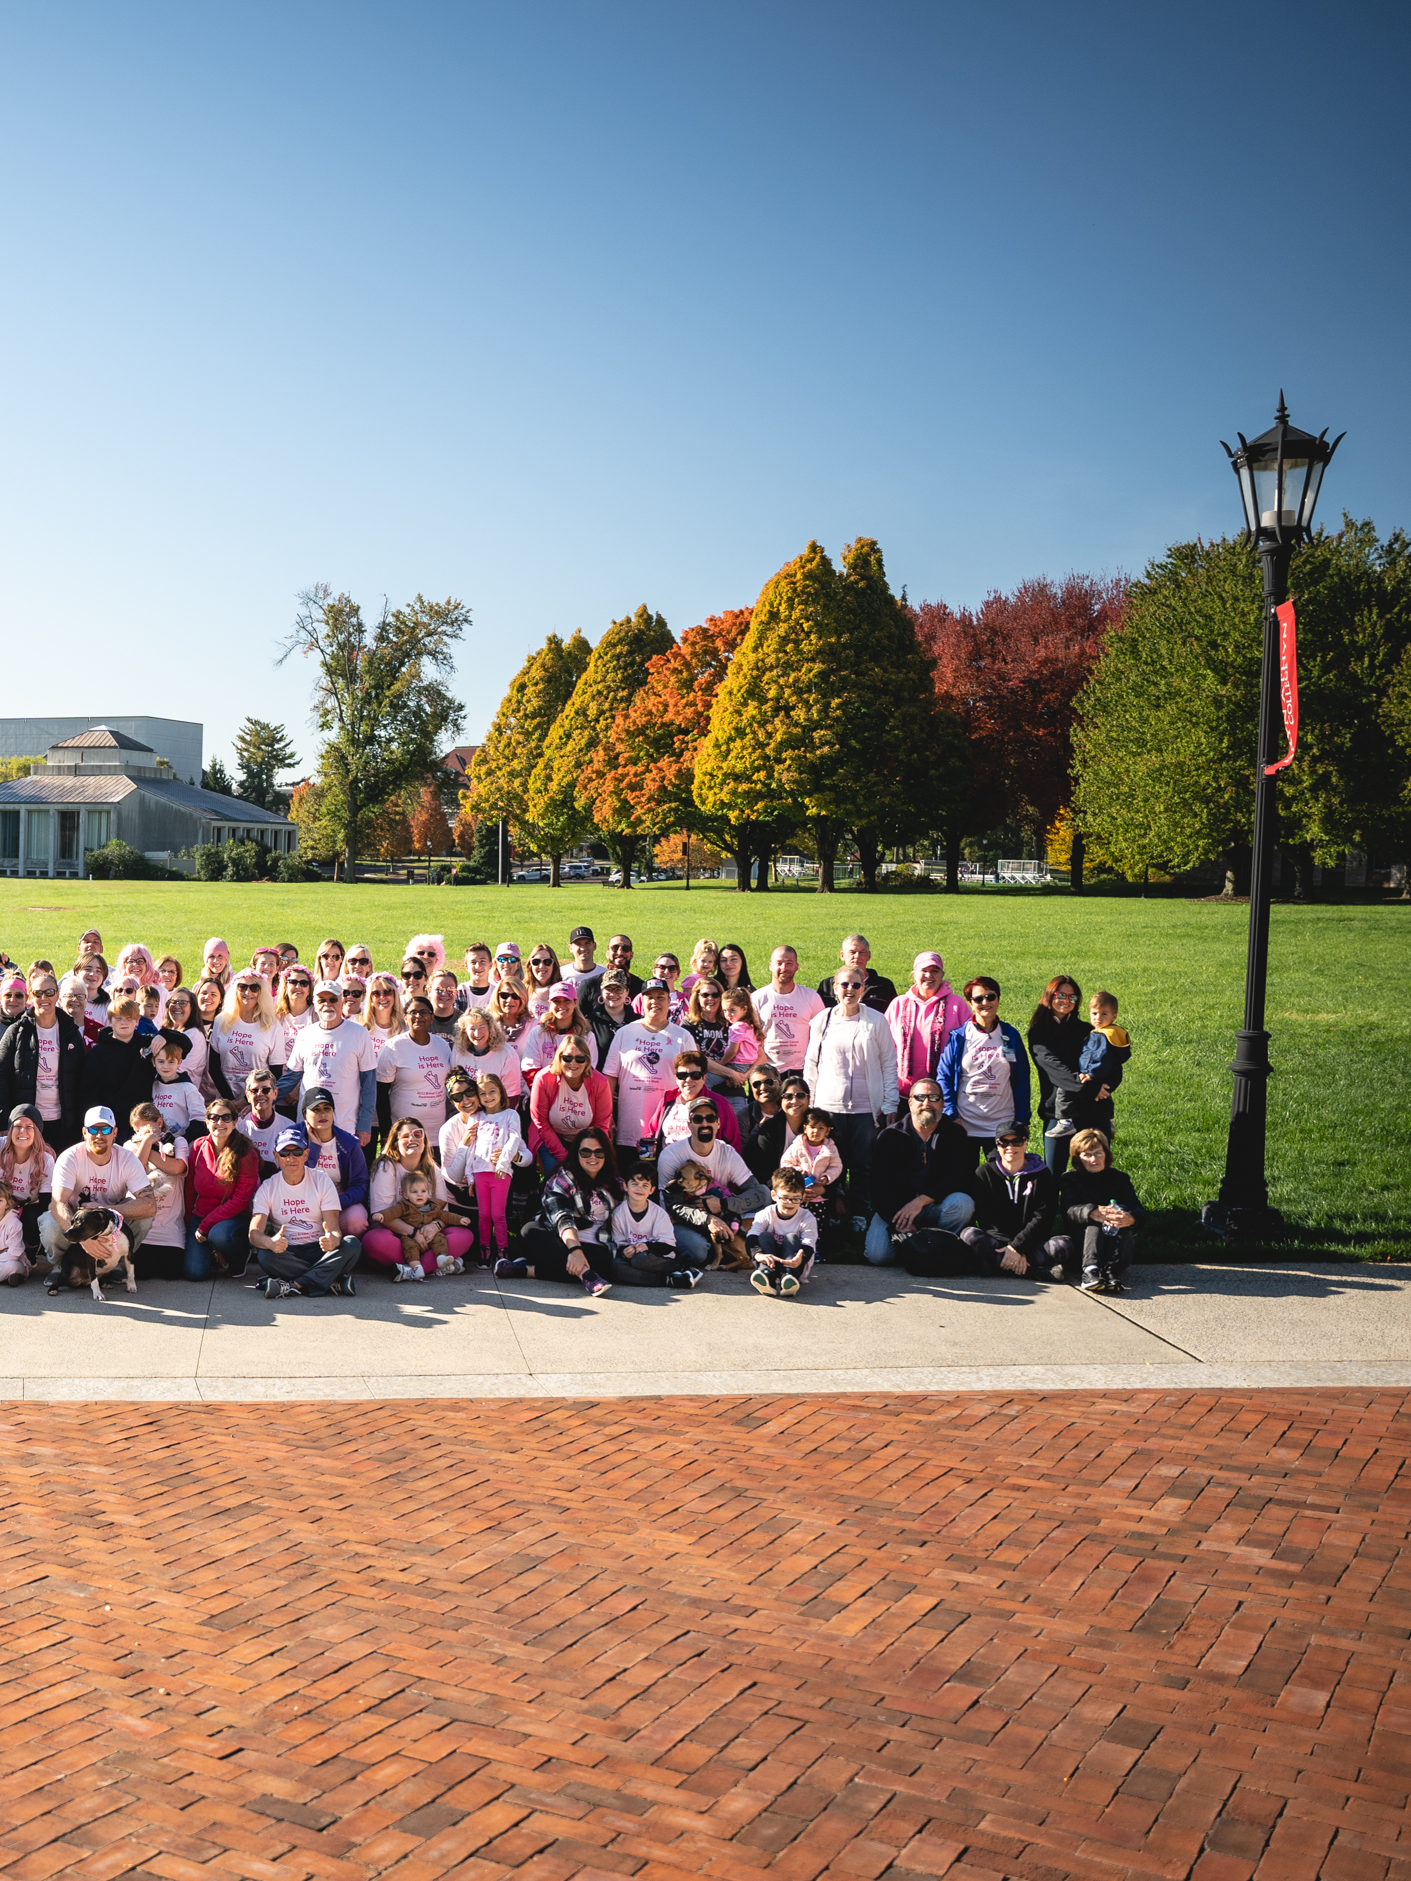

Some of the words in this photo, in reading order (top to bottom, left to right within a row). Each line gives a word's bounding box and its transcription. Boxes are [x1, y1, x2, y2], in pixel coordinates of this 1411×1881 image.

[773, 1004, 794, 1012] Hope
[232, 1030, 252, 1039] Hope
[235, 1038, 254, 1046] Here
[314, 1042, 334, 1050] Hope
[635, 1038, 661, 1047] #Hope
[563, 1097, 583, 1108] Hope
[559, 1104, 566, 1112] is
[567, 1106, 586, 1116] Here
[317, 1161, 336, 1169] Here
[89, 1176, 106, 1184] Hope
[283, 1199, 305, 1207] Hope
[281, 1207, 288, 1215] is
[290, 1207, 310, 1215] Here
